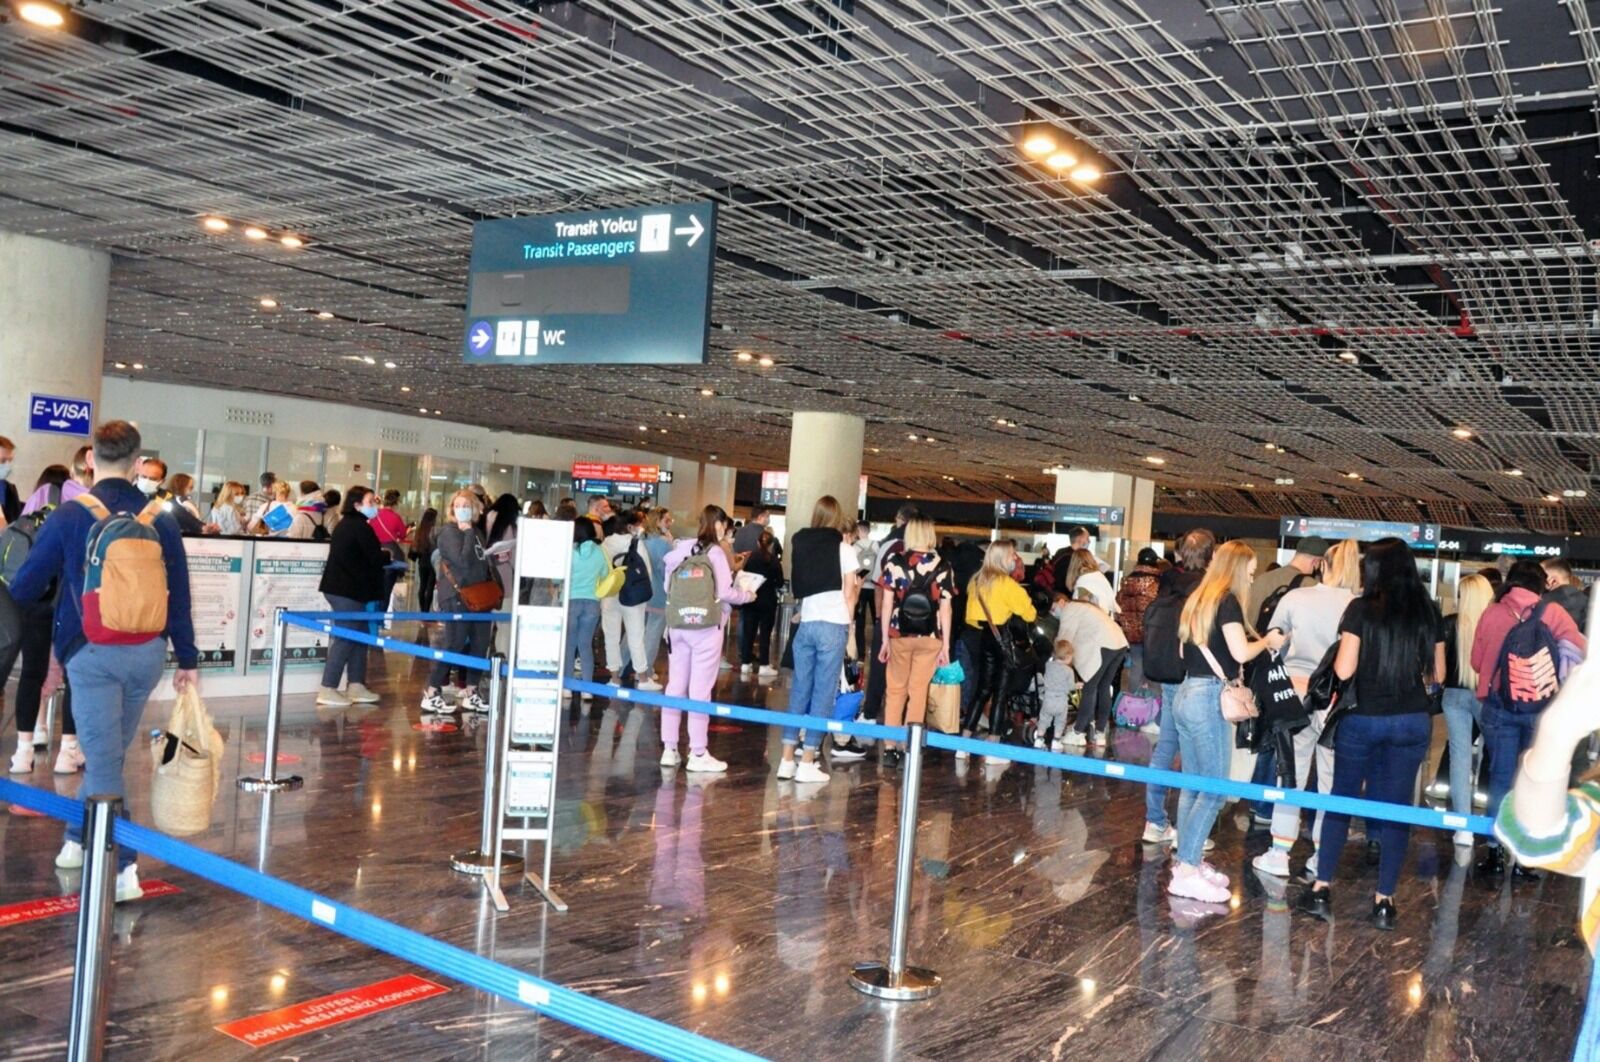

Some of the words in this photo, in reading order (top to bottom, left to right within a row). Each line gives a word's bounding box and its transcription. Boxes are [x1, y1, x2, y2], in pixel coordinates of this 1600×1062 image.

[555, 219, 598, 237] Transit
[601, 216, 637, 234] Yolcu
[523, 243, 564, 259] Transit
[566, 239, 636, 258] Passengers
[543, 330, 566, 345] WC
[32, 400, 90, 420] E-VISA
[647, 484, 654, 494] 2
[764, 491, 771, 501] 3
[999, 503, 1006, 515] 5
[1110, 510, 1118, 522] 6
[1286, 521, 1295, 532] 7
[1424, 528, 1434, 541] 8
[244, 1022, 303, 1041] SOSYAL
